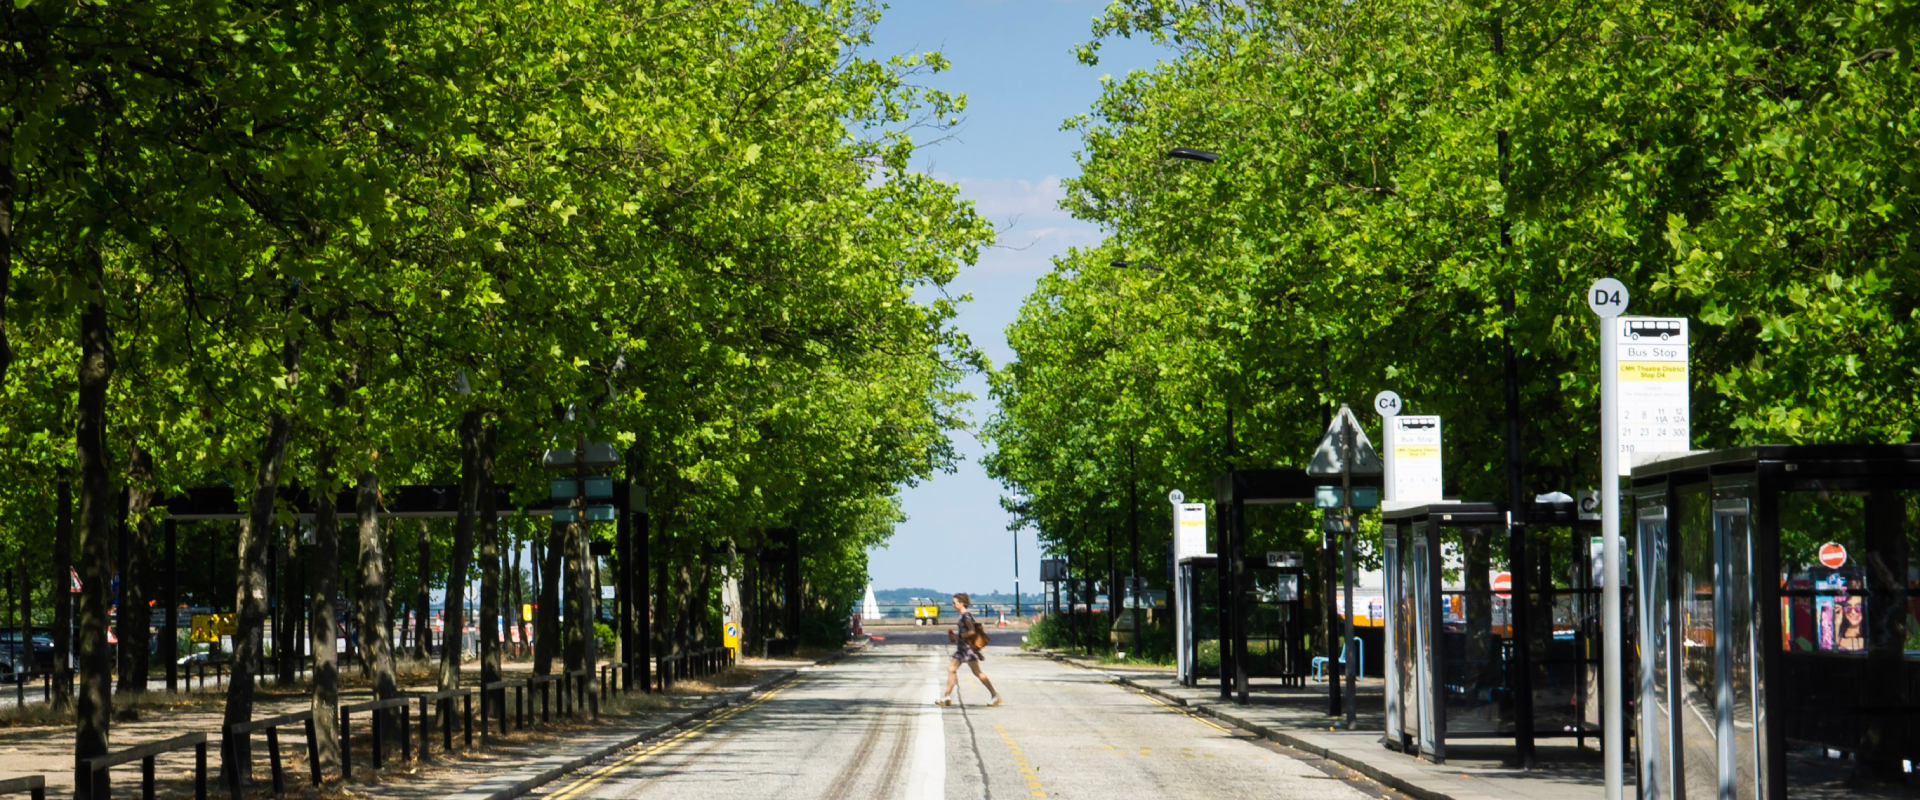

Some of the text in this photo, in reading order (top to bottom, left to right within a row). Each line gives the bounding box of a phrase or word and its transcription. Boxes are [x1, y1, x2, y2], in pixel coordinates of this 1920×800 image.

[1595, 290, 1621, 306] D4
[1628, 348, 1678, 358] Bus Stop
[1379, 398, 1396, 408] C4
[1624, 411, 1629, 419] 2
[1622, 428, 1631, 436] 21
[1640, 428, 1649, 436] 23
[1657, 428, 1666, 436] 24
[1620, 444, 1635, 452] 310
[1582, 497, 1596, 513] C
